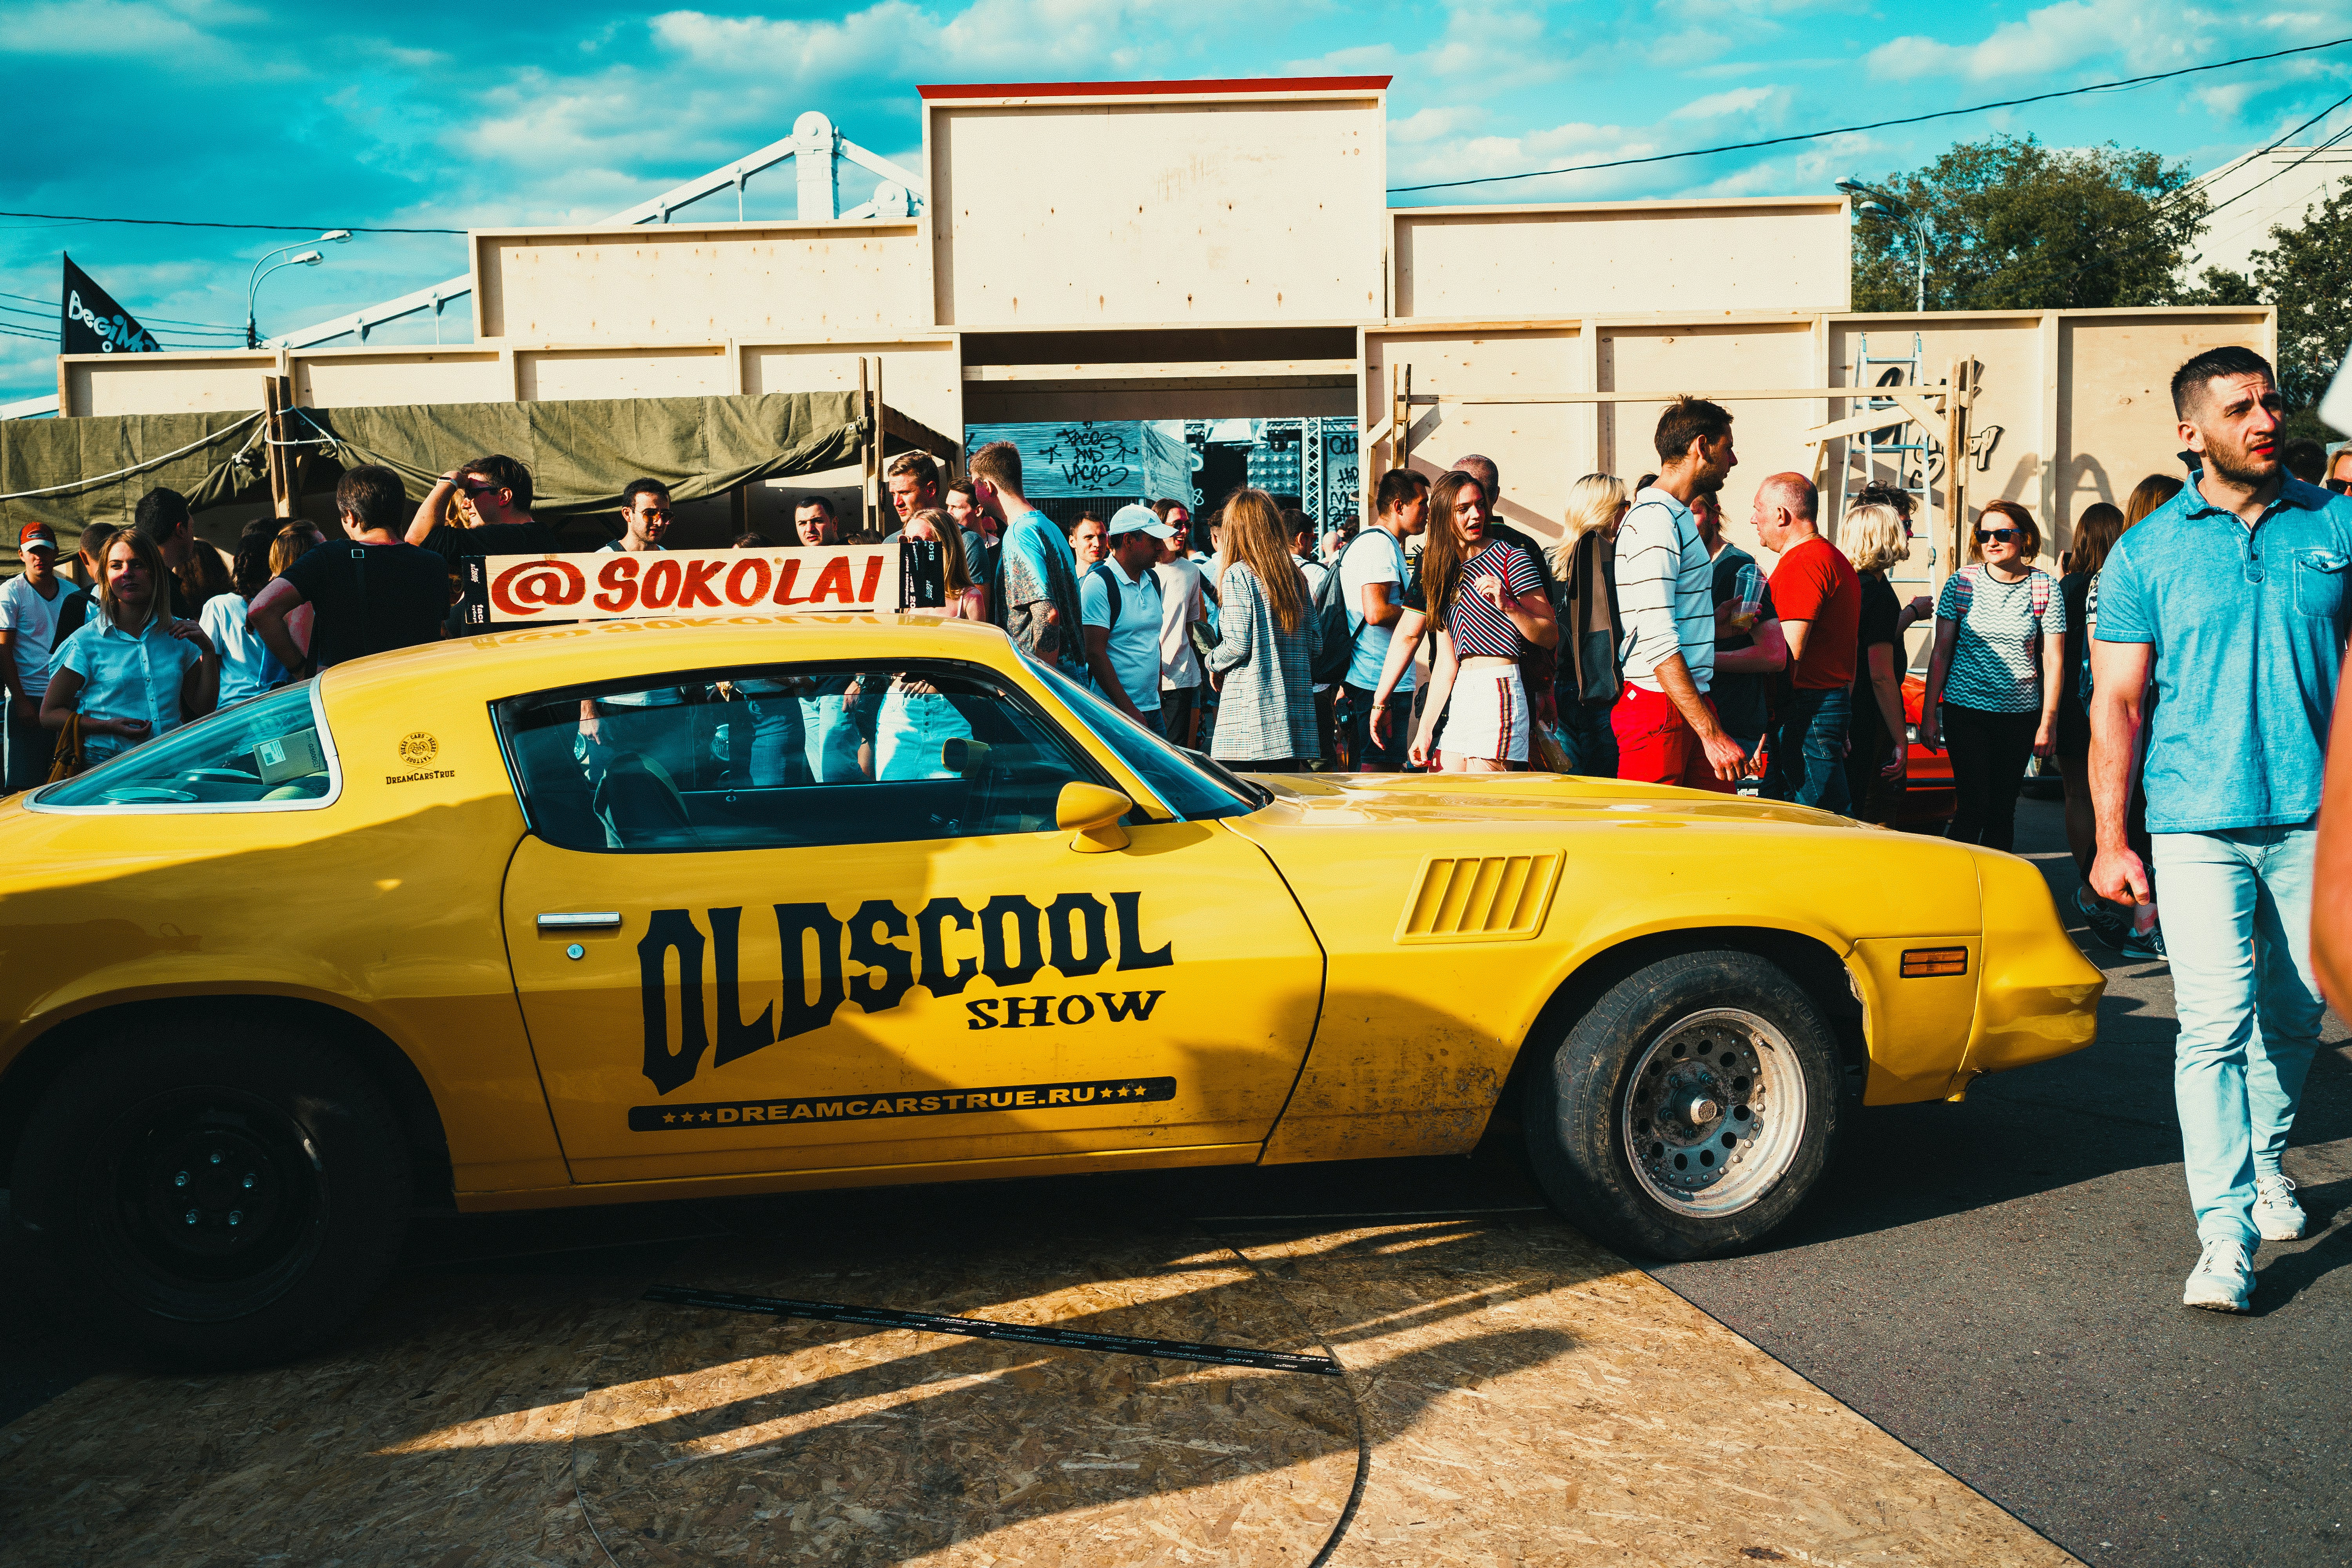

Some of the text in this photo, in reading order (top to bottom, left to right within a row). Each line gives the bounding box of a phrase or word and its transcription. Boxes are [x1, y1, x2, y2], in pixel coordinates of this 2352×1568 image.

[1074, 446, 1104, 464] AND
[491, 555, 884, 615] @SOKOLAI
[406, 755, 431, 764] TATTOOS
[428, 737, 436, 753] BEERS
[637, 892, 1174, 1096] OLDSCOOL
[966, 991, 1165, 1029] SHOW
[717, 1087, 1095, 1122] DREAMCARSTRUE.RU
